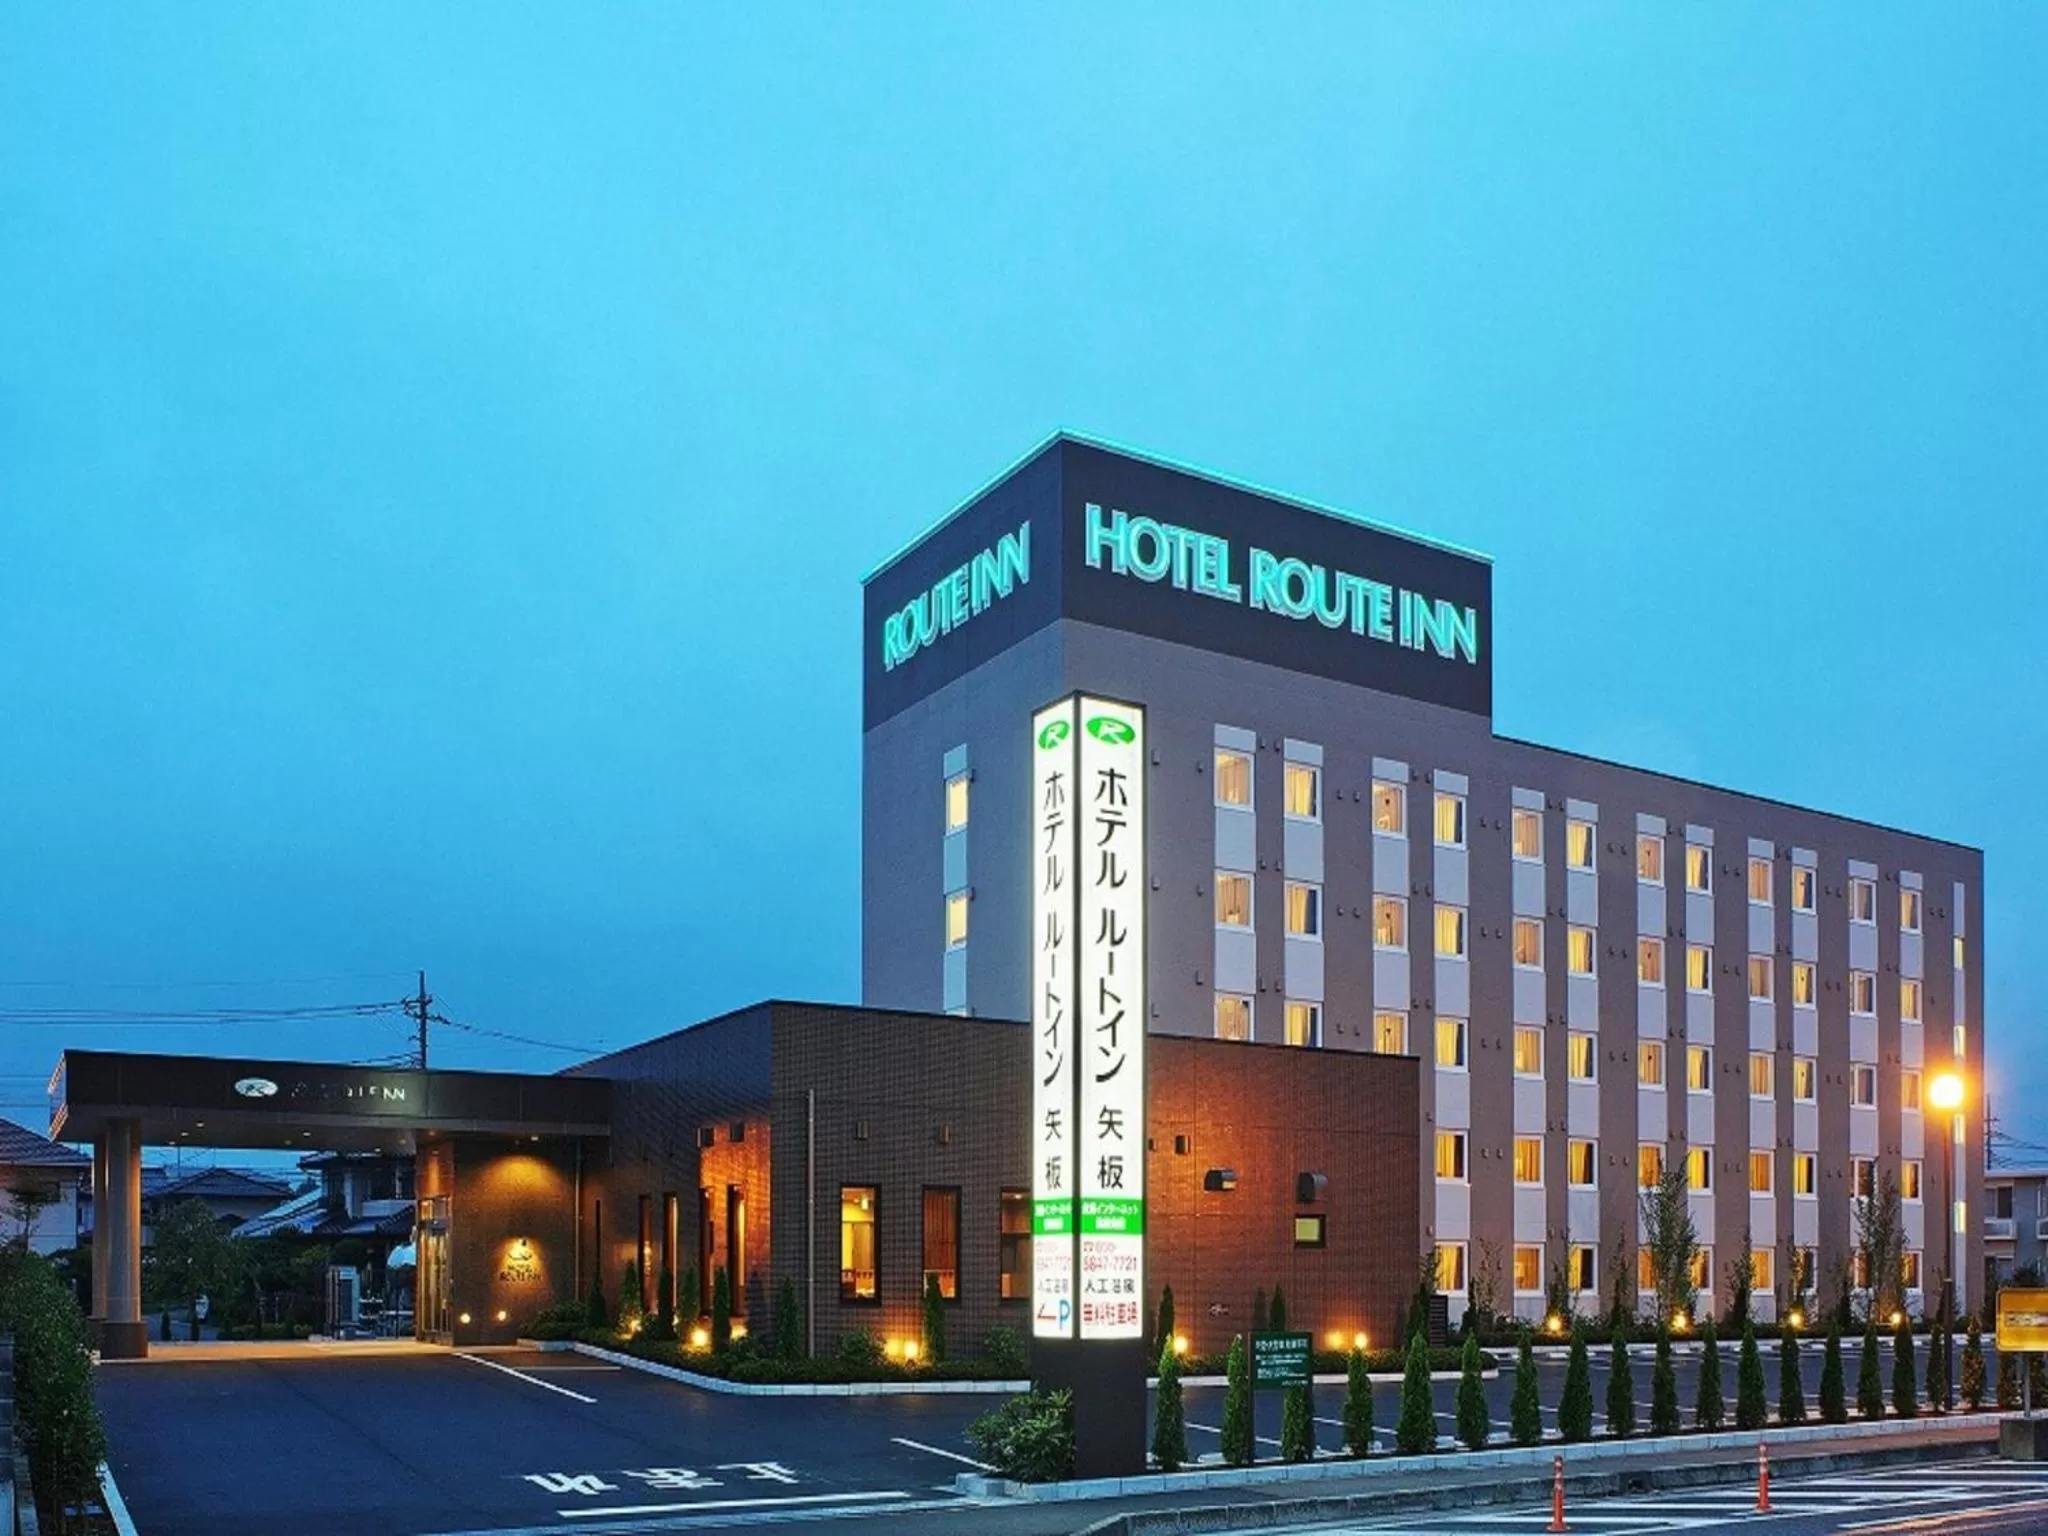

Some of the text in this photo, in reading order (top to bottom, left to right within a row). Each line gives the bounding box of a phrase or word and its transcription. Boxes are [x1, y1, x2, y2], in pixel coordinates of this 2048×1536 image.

[883, 521, 1030, 671] ROUTE INN
[1086, 502, 1477, 664] HOTEL ROUTE INN
[1043, 771, 1065, 895] ホテル
[1095, 768, 1128, 889] ホテル
[1043, 911, 1064, 1087] ルートイン
[1095, 908, 1127, 1083] ルートイン
[1045, 1109, 1062, 1190] 矢板
[1097, 1104, 1124, 1190] 矢板
